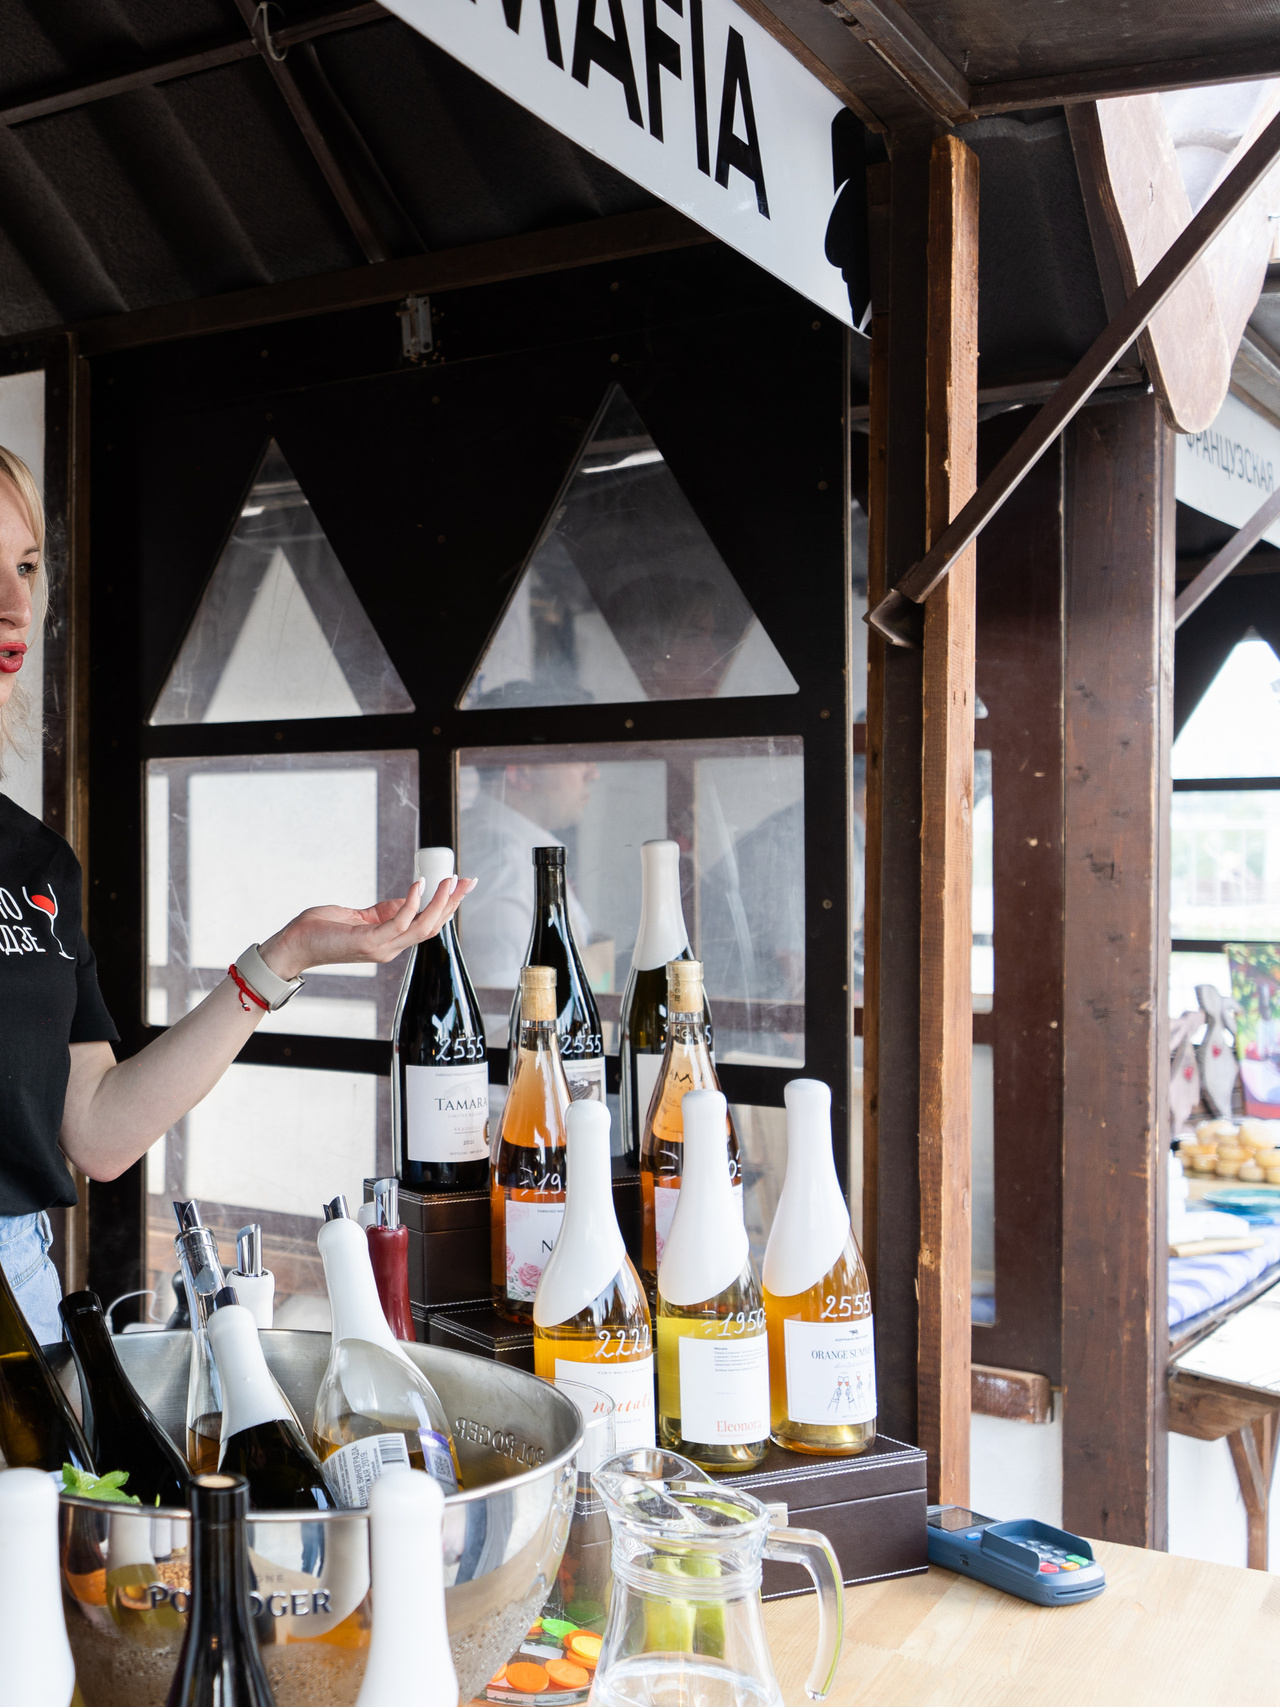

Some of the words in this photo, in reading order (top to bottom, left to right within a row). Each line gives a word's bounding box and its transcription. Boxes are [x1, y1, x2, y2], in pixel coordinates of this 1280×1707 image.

[436, 1035, 484, 1061] 2555
[561, 1034, 601, 1054] 2555
[820, 1291, 871, 1319] 2555
[595, 1324, 651, 1358] 2222
[811, 1350, 849, 1360] ORANGE
[716, 1420, 762, 1433] Eleonora
[147, 1581, 192, 1613] PO
[249, 1588, 333, 1617] OGER
